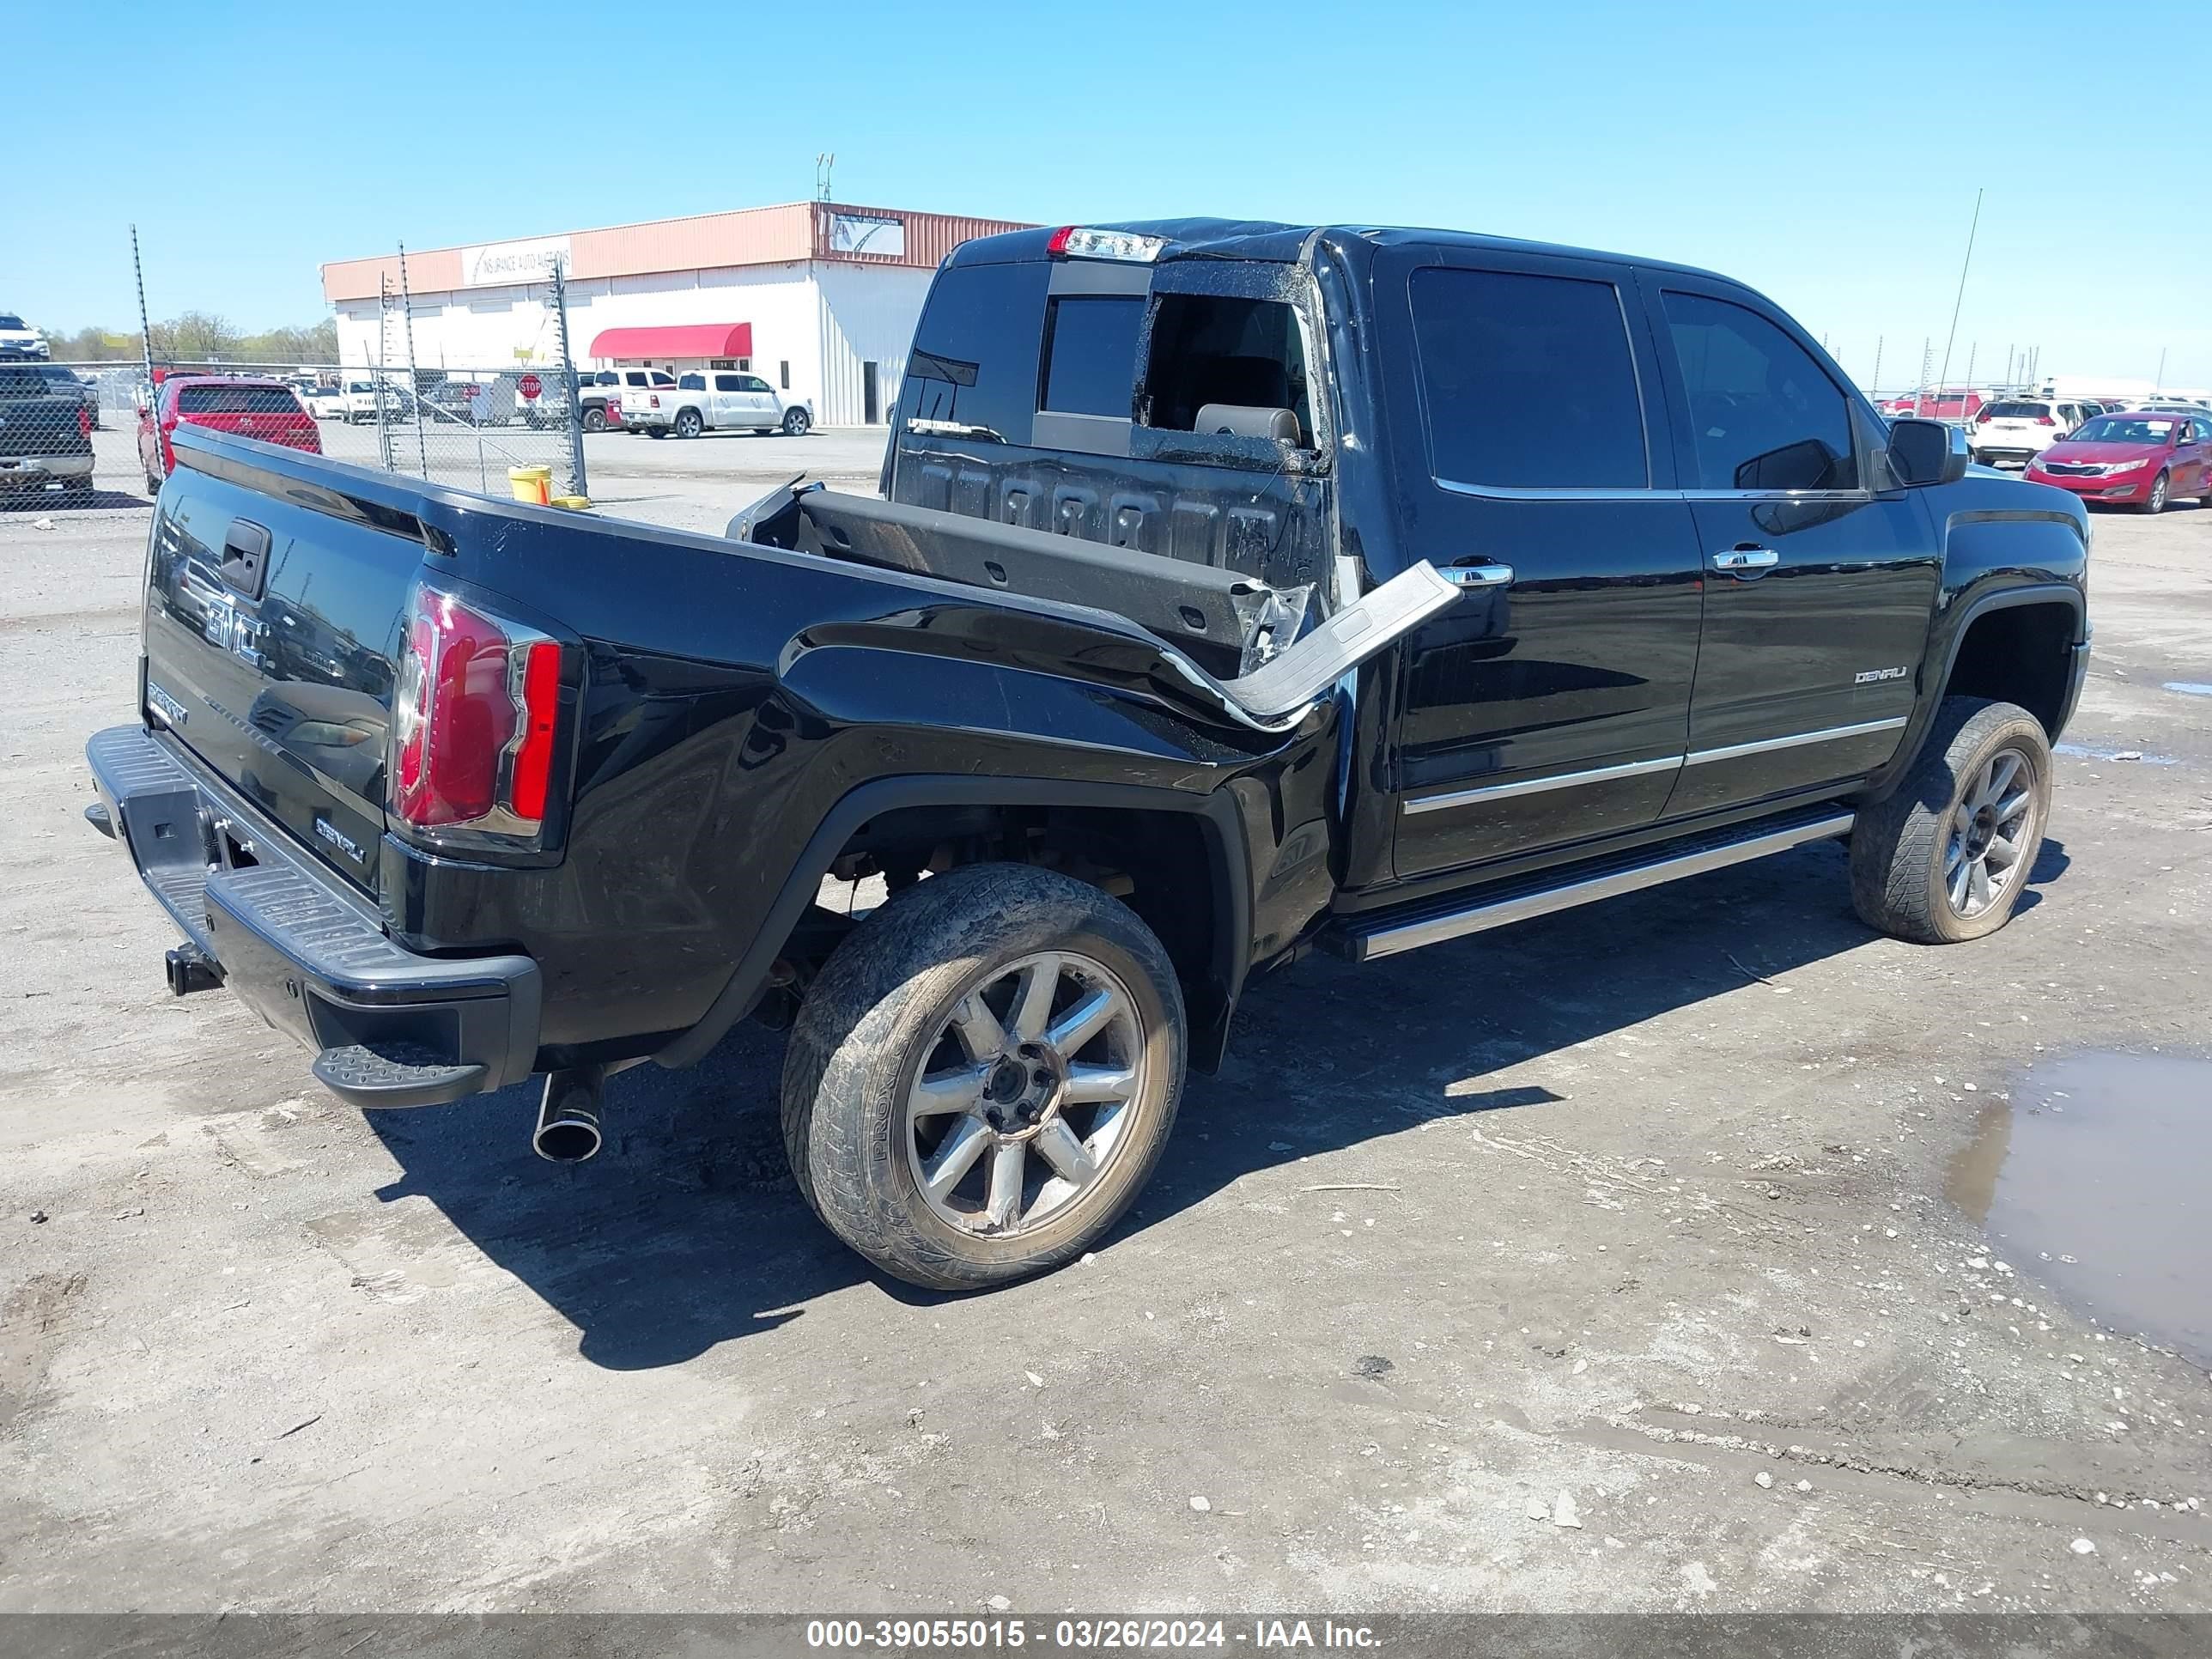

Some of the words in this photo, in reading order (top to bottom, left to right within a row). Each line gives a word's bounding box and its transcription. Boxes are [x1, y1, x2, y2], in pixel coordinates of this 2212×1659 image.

[518, 252, 536, 270] AUTO
[520, 381, 541, 392] STOP
[207, 599, 270, 667] GMC
[1854, 665, 1908, 684] DENALI
[315, 817, 368, 865] DENALI
[872, 1036, 910, 1162] PROXES
